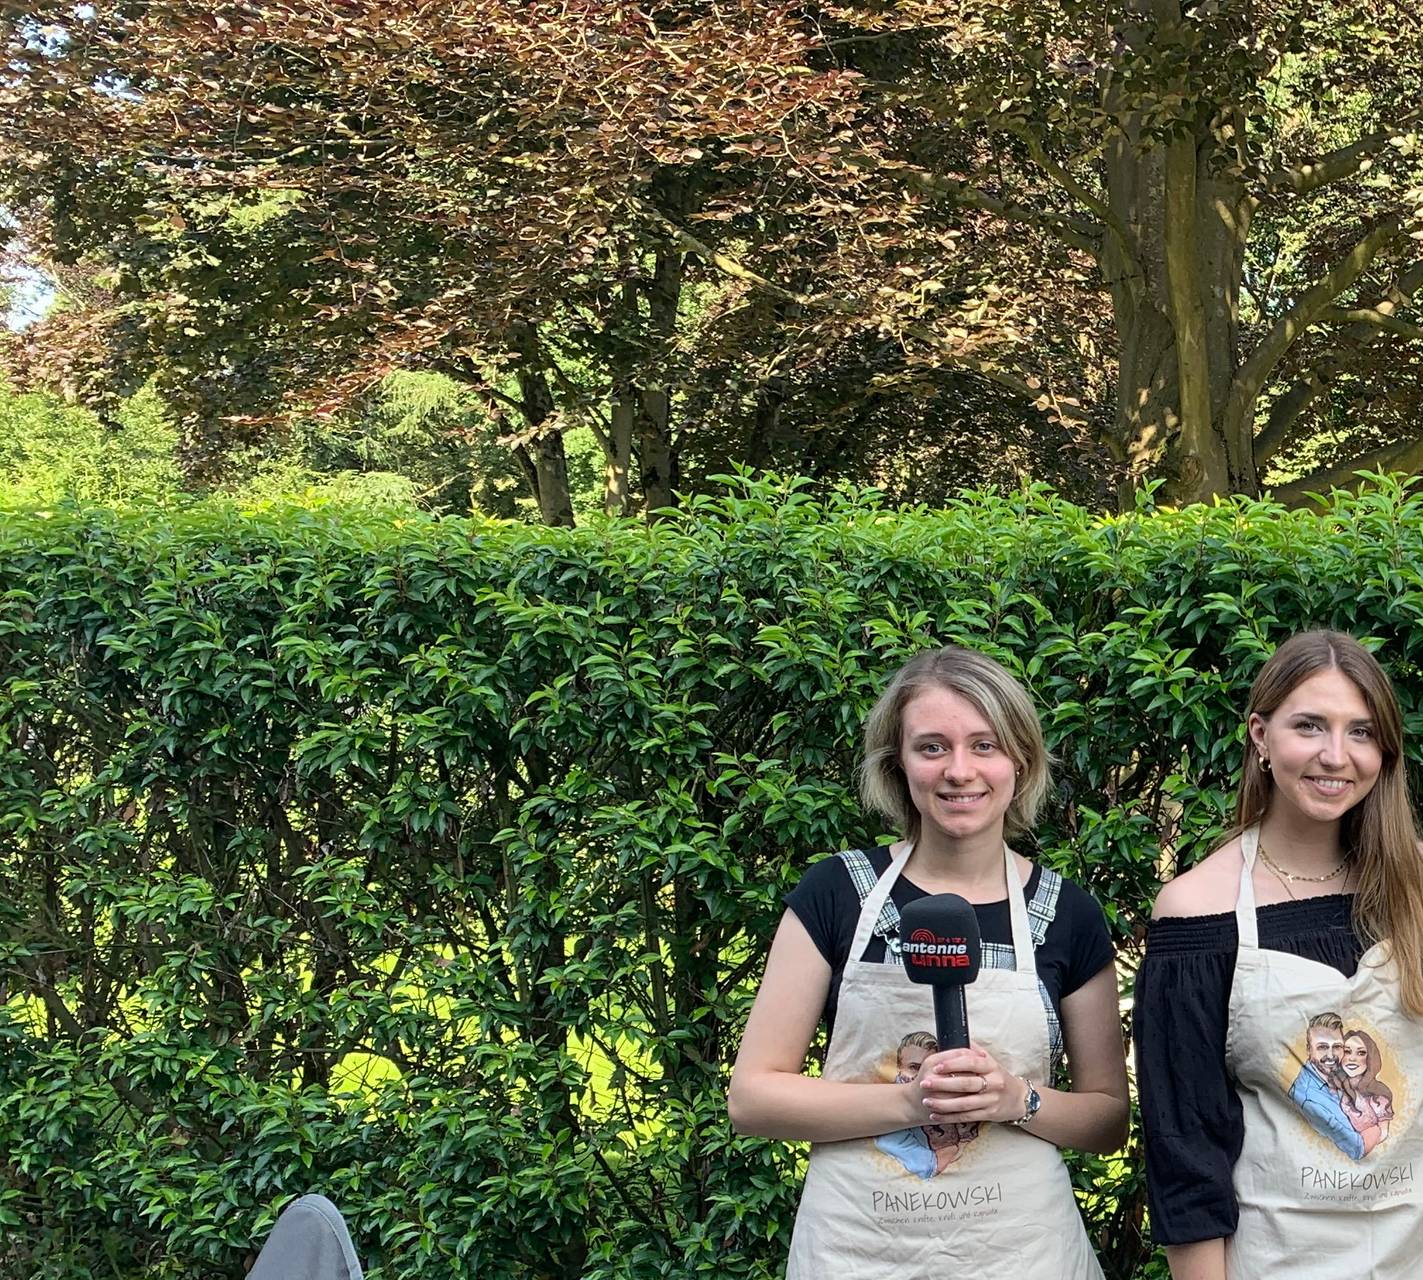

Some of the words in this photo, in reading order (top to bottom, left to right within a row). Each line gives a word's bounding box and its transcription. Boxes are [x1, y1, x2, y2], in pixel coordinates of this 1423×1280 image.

[902, 942, 967, 954] antenne
[911, 954, 971, 968] unna
[1301, 1162, 1414, 1190] PANEKOWSKI
[872, 1182, 1002, 1212] PANEKOWSKI
